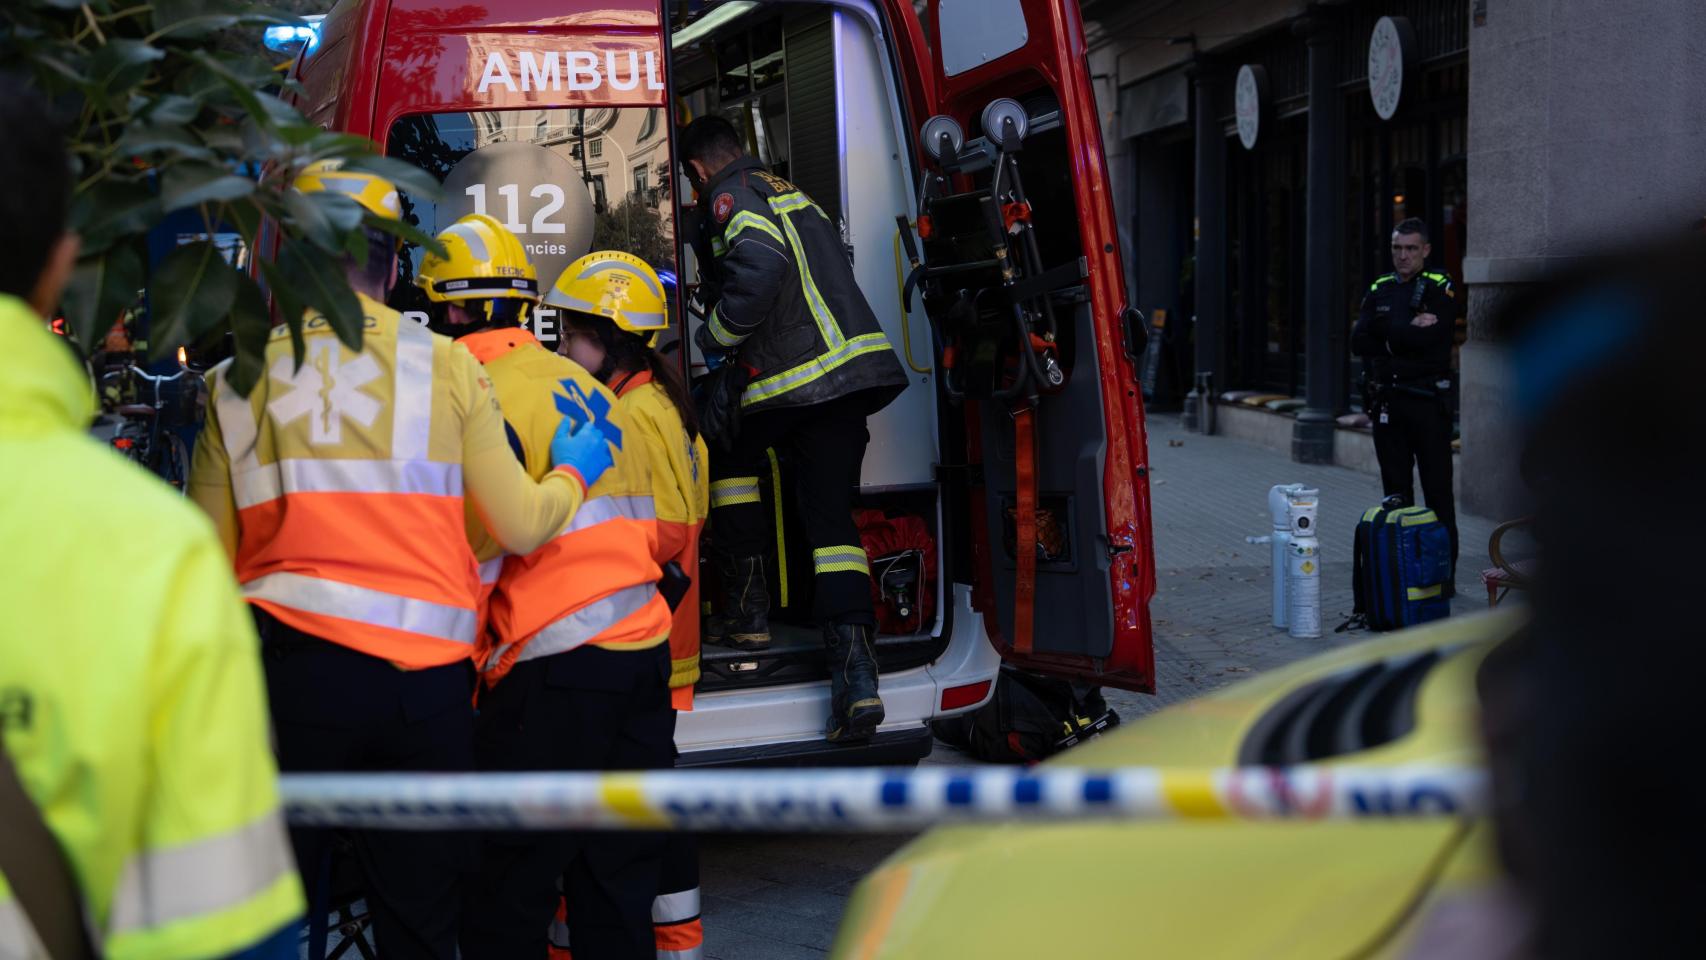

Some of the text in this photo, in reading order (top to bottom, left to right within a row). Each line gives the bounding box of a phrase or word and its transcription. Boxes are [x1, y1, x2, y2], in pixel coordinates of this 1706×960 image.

[477, 50, 665, 93] AMBUL
[465, 183, 566, 234] 112
[525, 240, 567, 255] ncies
